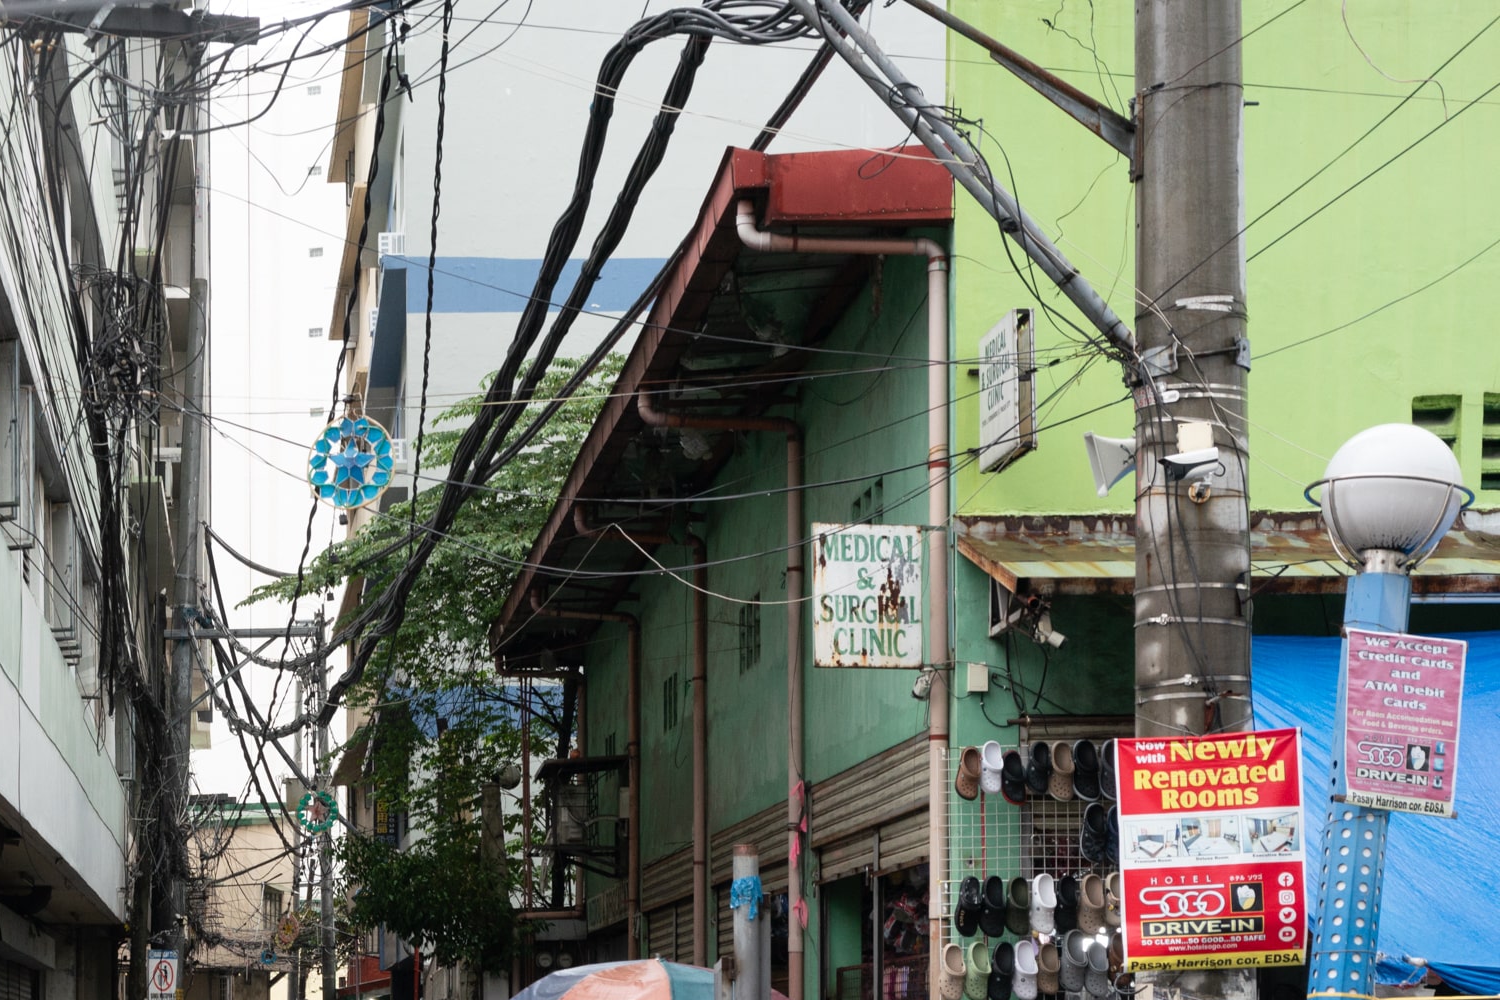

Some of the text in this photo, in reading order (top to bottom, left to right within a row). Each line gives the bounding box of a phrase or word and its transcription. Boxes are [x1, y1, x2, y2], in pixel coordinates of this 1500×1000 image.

[984, 329, 1007, 358] MEDICAL
[819, 533, 919, 563] MEDICAL
[856, 567, 876, 590] &
[819, 594, 921, 624] SURGICAL
[833, 628, 909, 658] CLINIC
[1365, 636, 1448, 654] We Accept
[1358, 650, 1454, 670] Credit Cards
[1391, 669, 1421, 680] and
[1364, 681, 1445, 698] ATM Debit
[1352, 708, 1365, 717] For
[1383, 697, 1427, 711] Cards
[1135, 741, 1166, 752] Now
[1170, 734, 1276, 762] Newly
[1357, 741, 1404, 768] SOGO
[1135, 753, 1166, 765] with
[1133, 760, 1286, 790] Renovated
[1356, 768, 1428, 786] DRIVE-IN
[1161, 786, 1259, 810] Rooms
[1352, 792, 1444, 814] Pasay Harrison cor. EDSA
[1150, 875, 1211, 885] HOTEL
[1139, 884, 1225, 919] SOGO
[1149, 918, 1255, 935] DRIVE-IN
[1168, 941, 1238, 952] www.hotelsogo.com
[1131, 953, 1300, 971] Pasay, Harrison cor. EDSA
